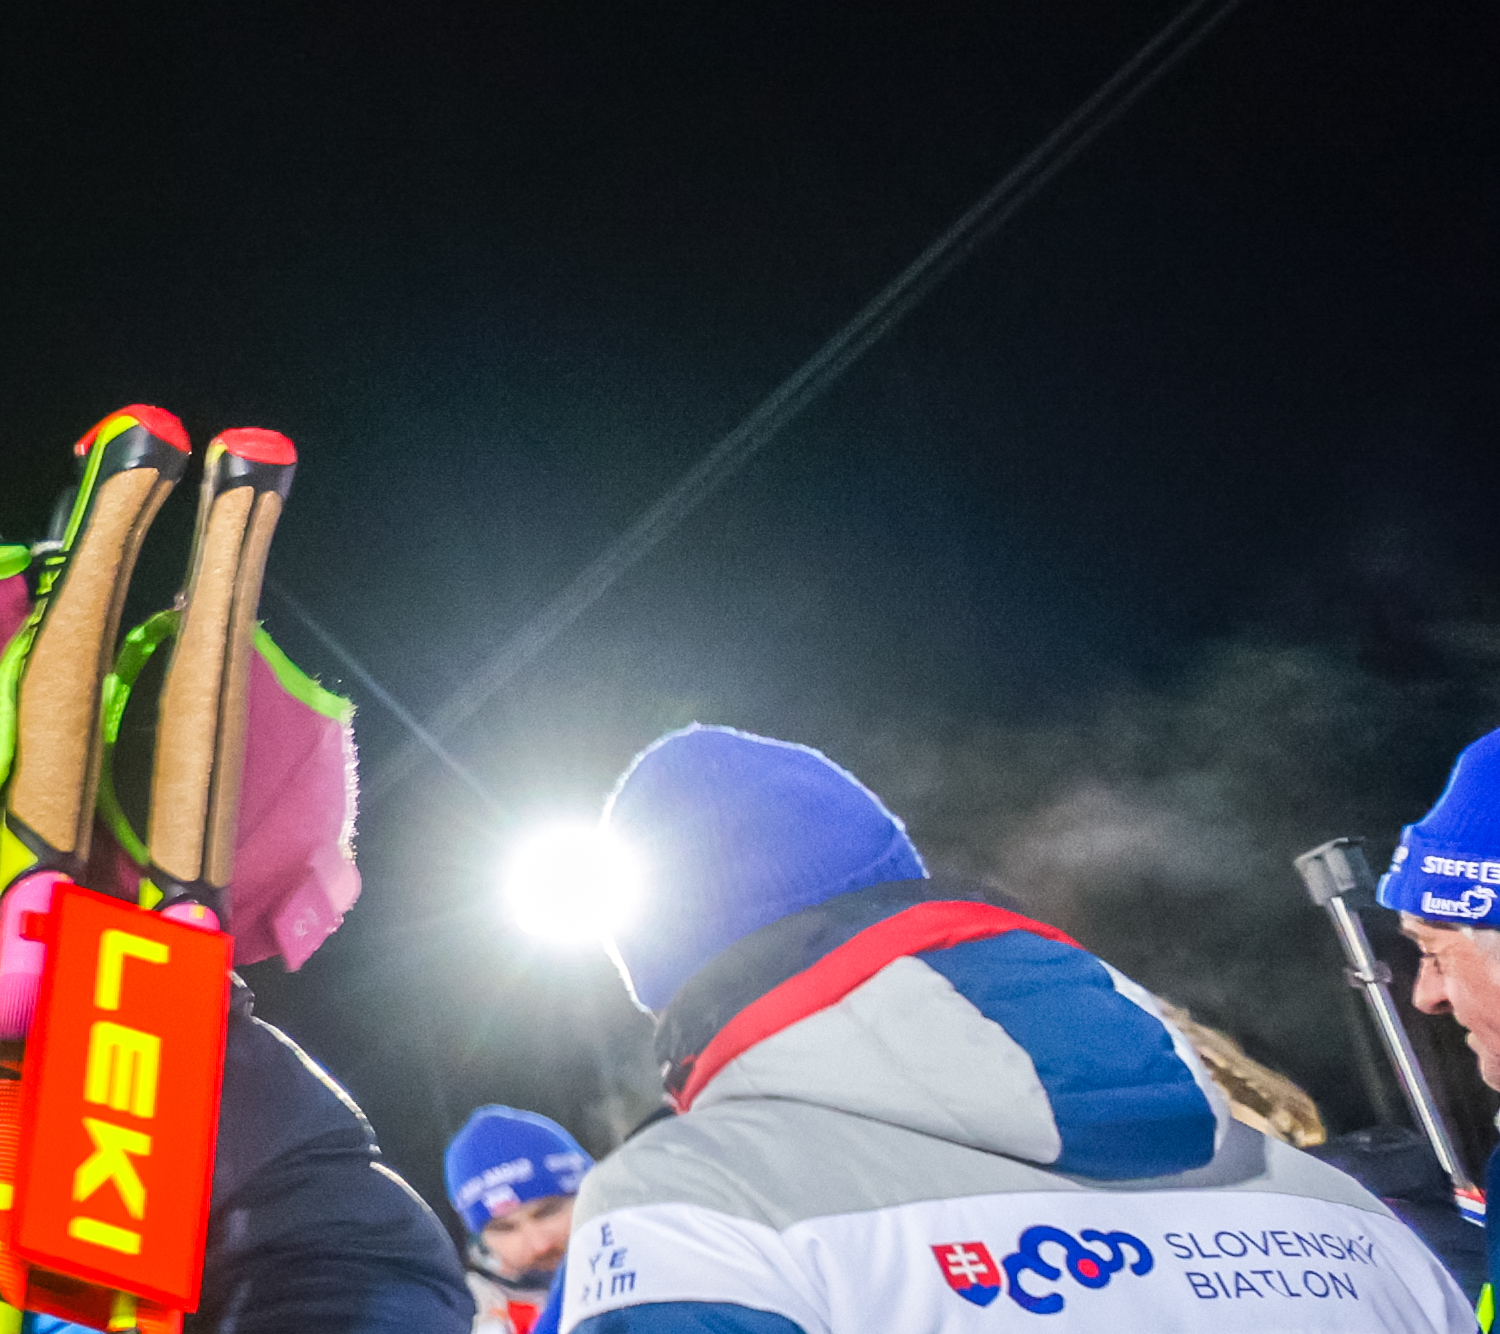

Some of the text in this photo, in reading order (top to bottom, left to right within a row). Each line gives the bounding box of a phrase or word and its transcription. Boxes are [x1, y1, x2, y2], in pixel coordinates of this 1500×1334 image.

[67, 928, 170, 1256] LEKI
[1163, 1229, 1377, 1269] SLOVENSKÝ
[1184, 1269, 1360, 1301] BIATLON
